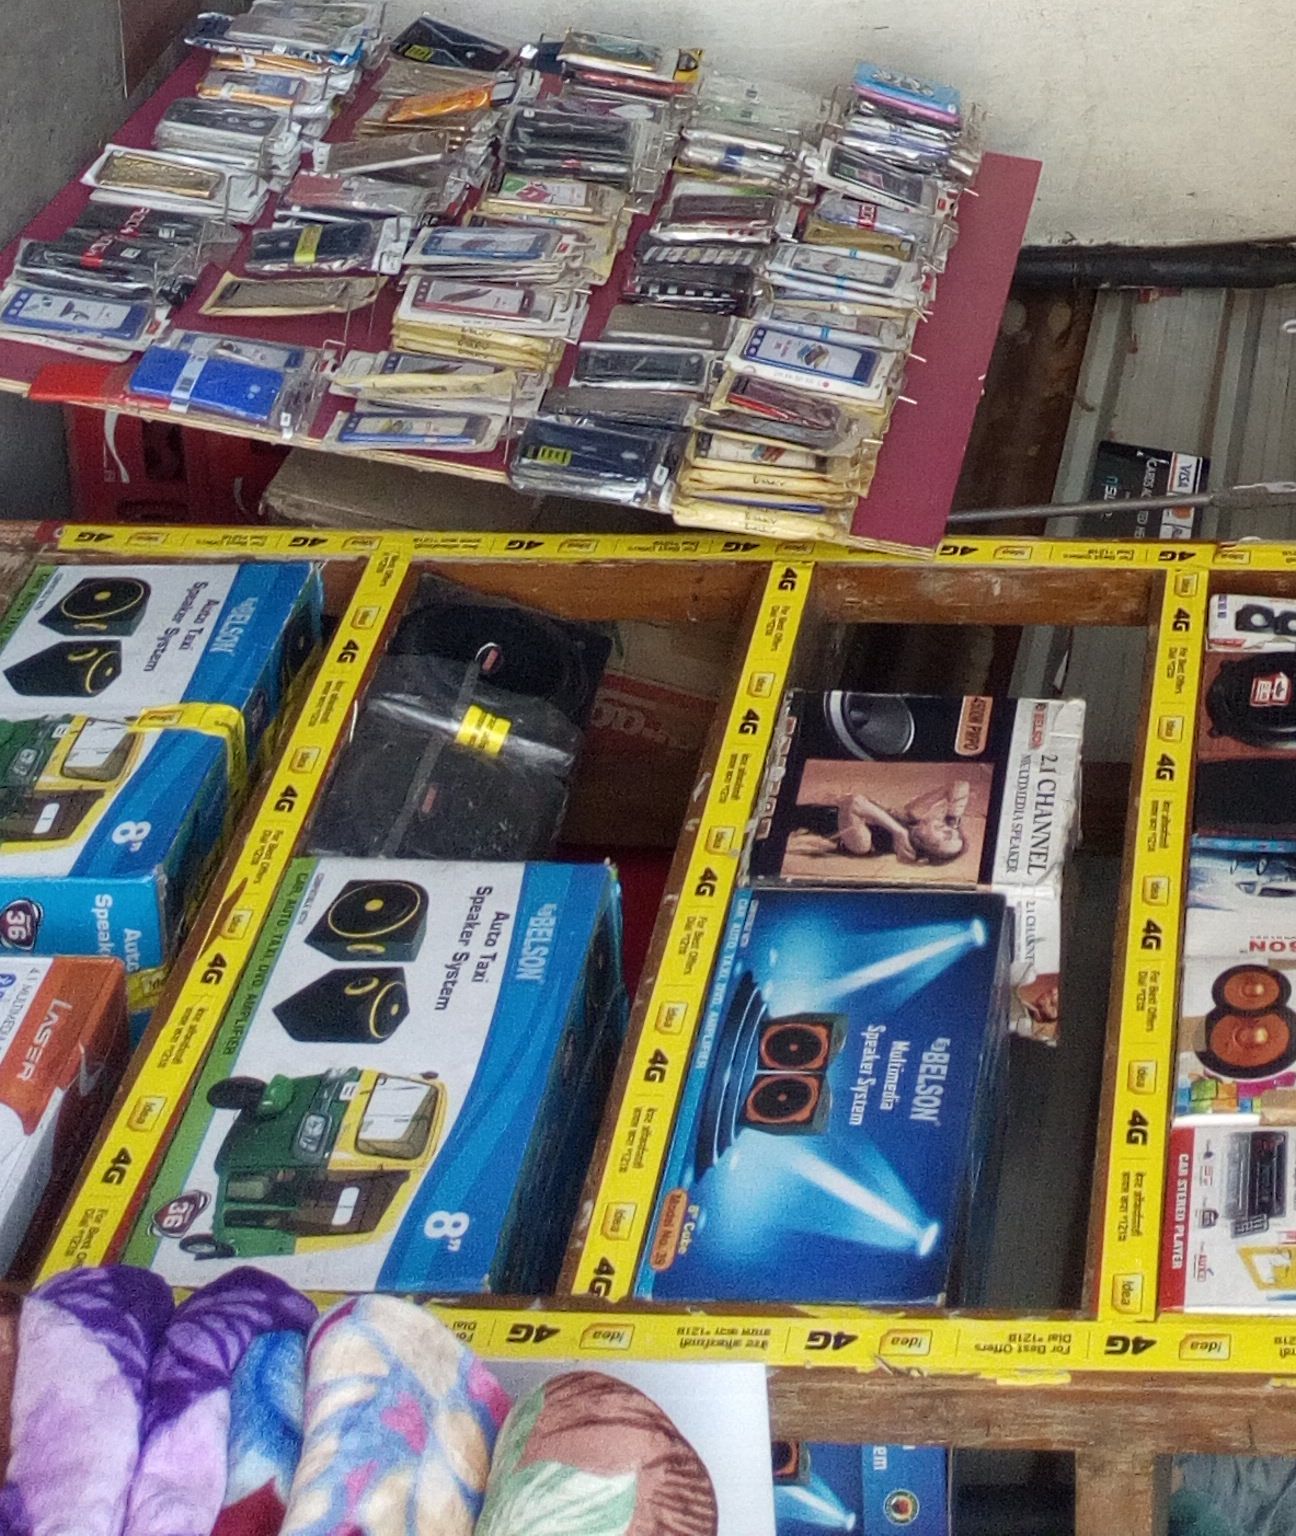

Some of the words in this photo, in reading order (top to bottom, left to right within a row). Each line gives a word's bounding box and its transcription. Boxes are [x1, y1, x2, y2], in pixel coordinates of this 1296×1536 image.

[1177, 463, 1192, 488] VISA
[171, 581, 209, 624] Speaker
[193, 599, 221, 625] Auto
[142, 627, 180, 673] System
[178, 627, 205, 651] Taxi
[336, 639, 361, 664] 4G
[738, 708, 760, 735] 4G
[274, 784, 299, 813] 4G
[1026, 779, 1056, 875] CHANNEL
[1005, 823, 1022, 873] SPEAKER
[694, 866, 718, 897] 4G
[5, 910, 27, 941] 36
[91, 893, 115, 956] Speak
[457, 885, 493, 947] Speaker
[483, 911, 511, 947] Auto
[515, 916, 557, 980] BELSON
[203, 953, 228, 986] 4G
[434, 951, 470, 1011] System
[471, 951, 497, 984] Taxi
[15, 998, 73, 1082] LASER
[222, 993, 259, 1056] AMPLIFIER
[643, 1048, 669, 1083] 4G
[859, 1024, 886, 1075] Speaker
[879, 1040, 911, 1111] Multimedia
[909, 1051, 951, 1122] BELSON
[848, 1077, 877, 1126] System
[100, 1147, 134, 1185] 4G
[1177, 1153, 1189, 1177] CAR
[162, 1201, 189, 1228] 36
[1174, 1178, 1187, 1222] STEREO
[1171, 1225, 1184, 1269] PLAYER
[590, 1256, 616, 1298] 4G
[505, 1323, 561, 1344] 4G
[804, 1330, 859, 1351] 4G
[1104, 1336, 1157, 1355] 4G
